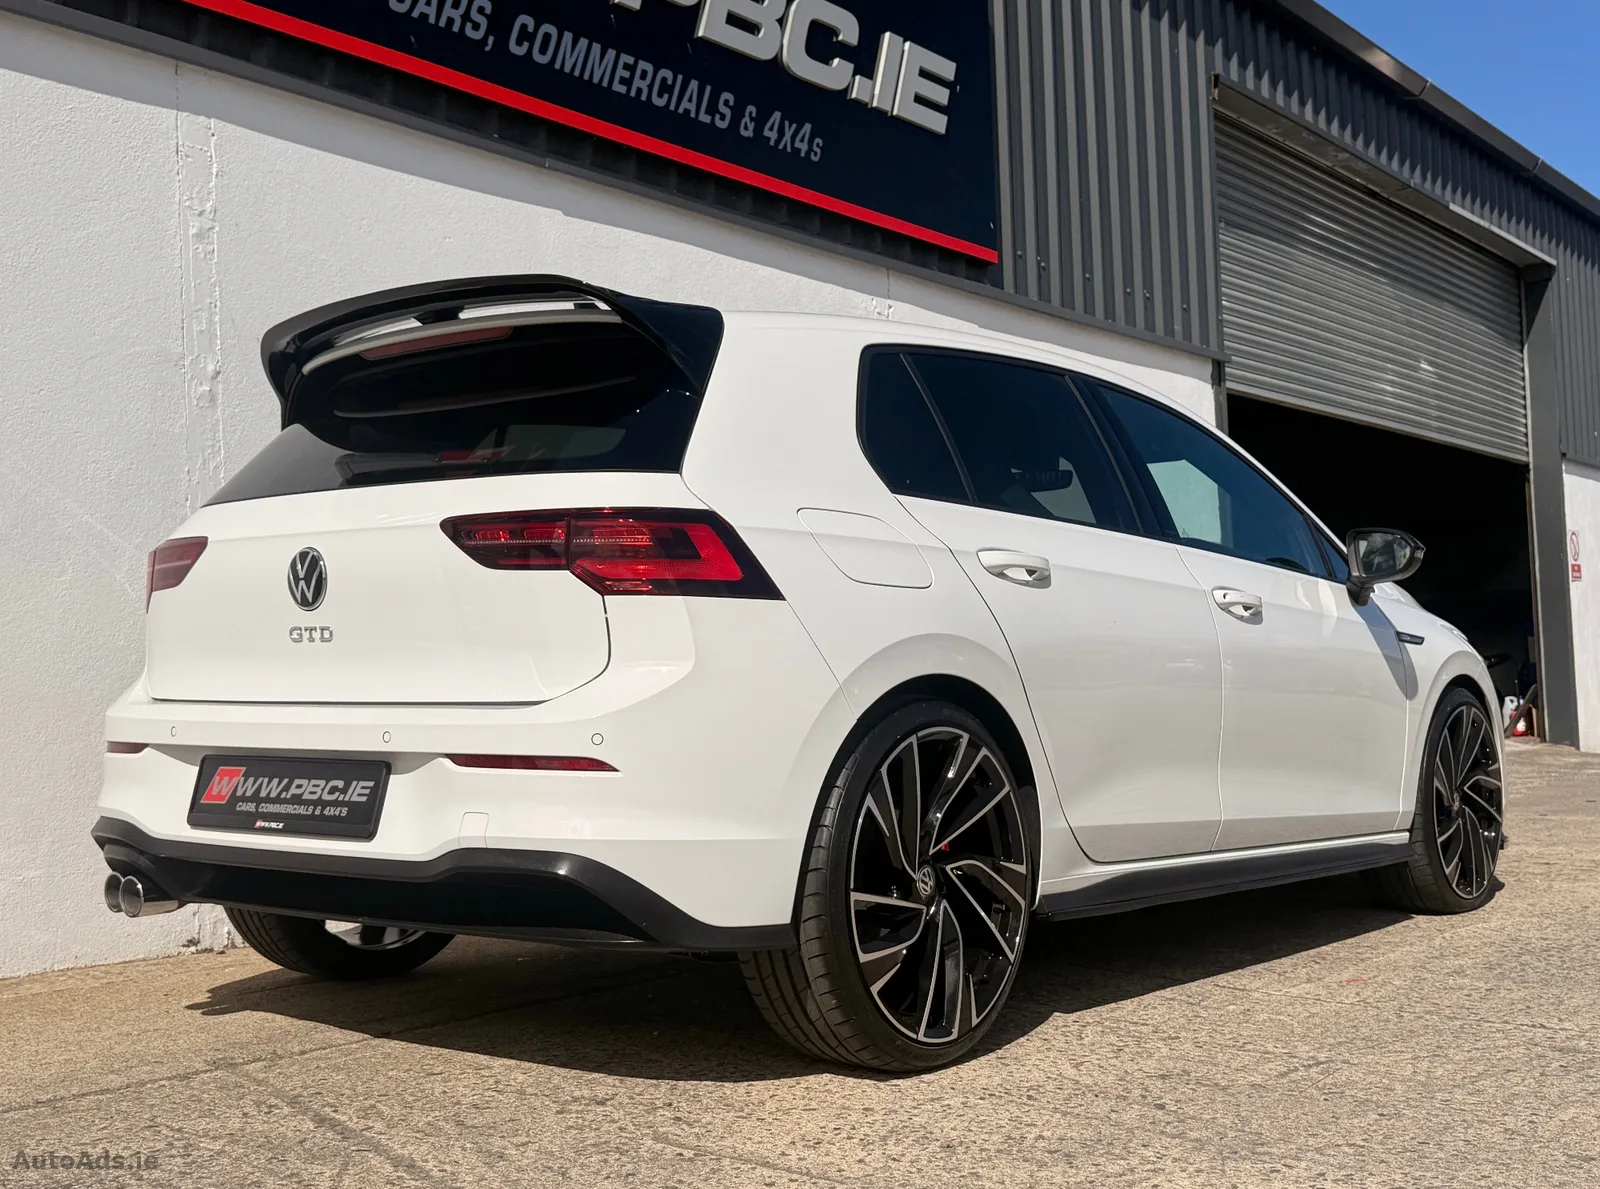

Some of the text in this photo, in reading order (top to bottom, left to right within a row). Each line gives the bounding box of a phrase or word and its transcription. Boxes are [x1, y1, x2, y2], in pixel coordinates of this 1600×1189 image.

[508, 14, 735, 130] COMMERCIALS
[739, 105, 757, 138] &
[602, 0, 957, 135] BC.IE
[289, 626, 333, 643] GTD
[212, 776, 375, 802] WWW.PBC.IE
[236, 801, 256, 813] CARS,
[258, 802, 313, 816] COMMERCIALS
[315, 807, 321, 816] &
